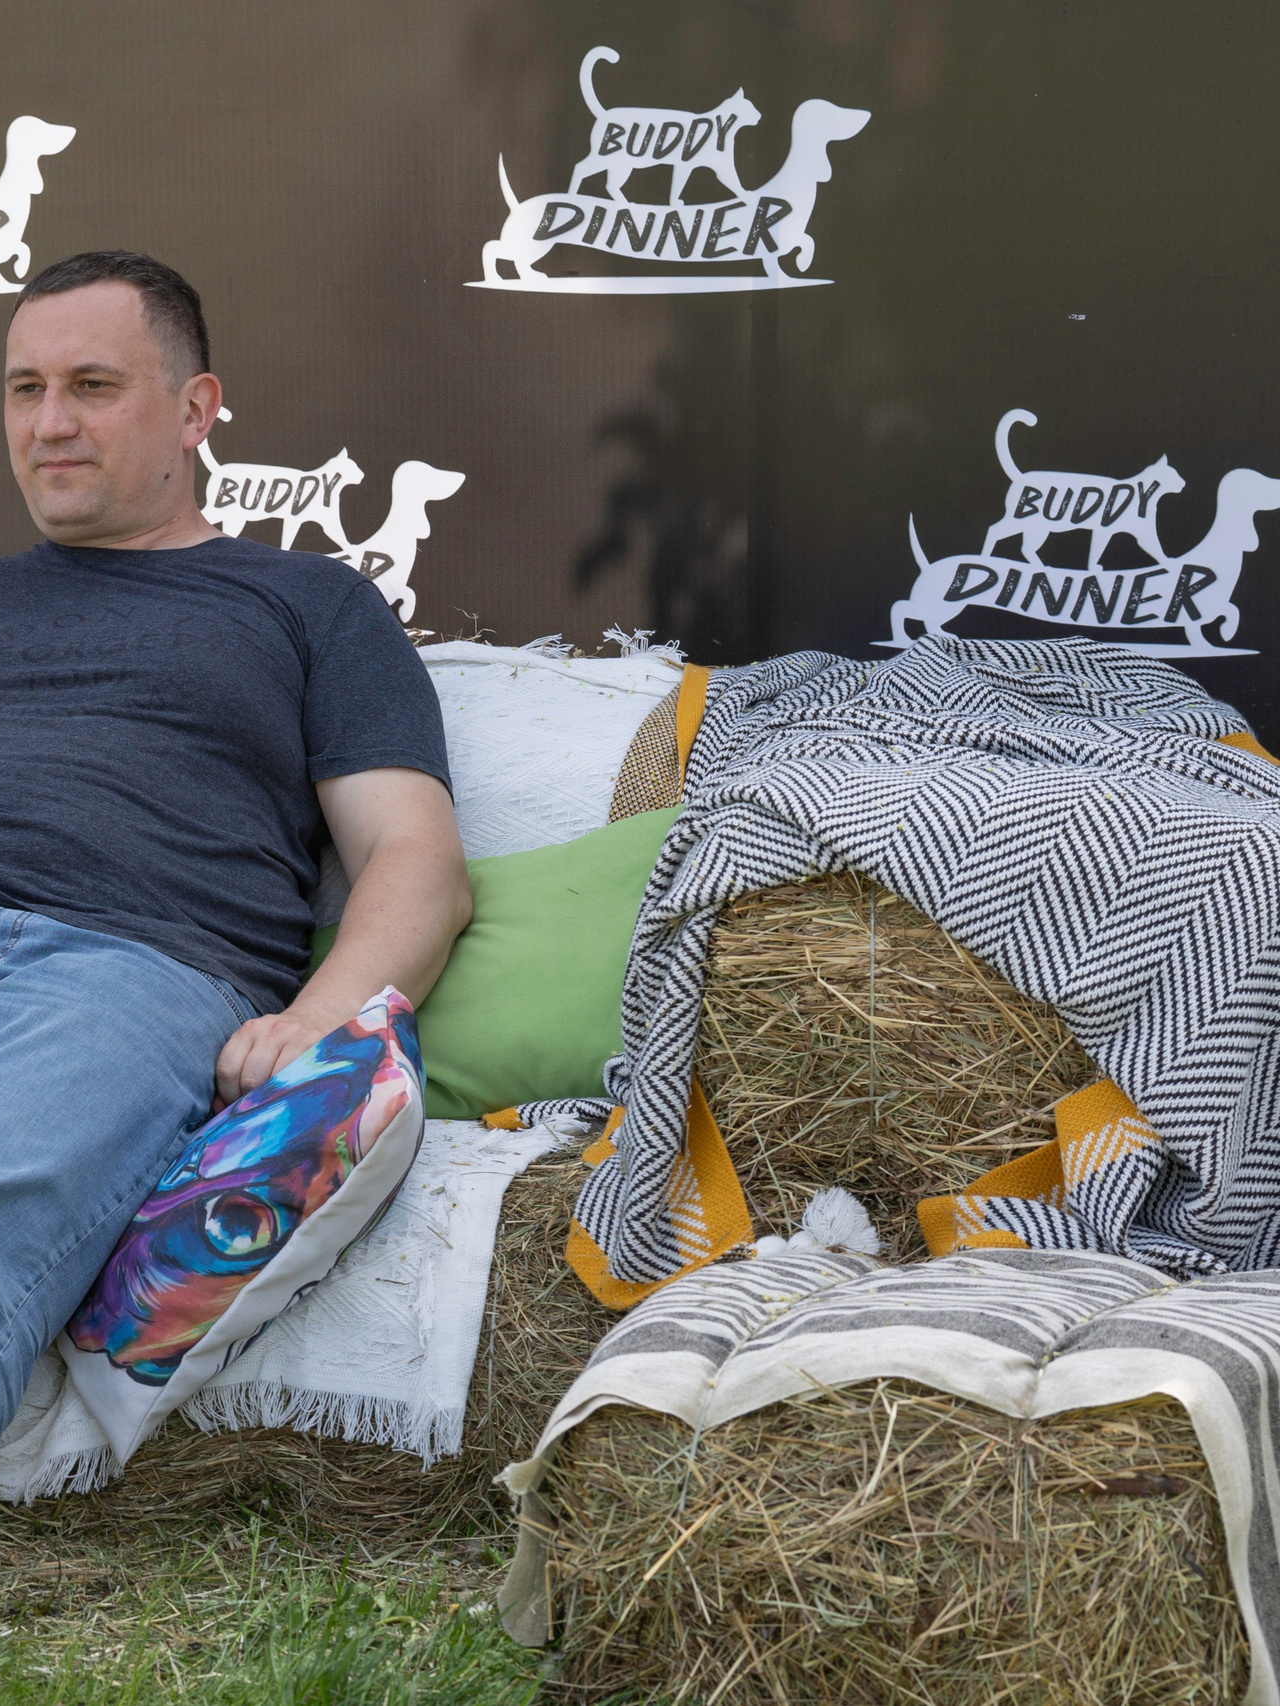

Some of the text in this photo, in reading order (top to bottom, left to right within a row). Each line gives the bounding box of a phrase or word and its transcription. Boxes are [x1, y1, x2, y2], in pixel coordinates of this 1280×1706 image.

[598, 114, 736, 162] BUDDY
[536, 197, 792, 259] DINNER
[214, 471, 341, 516] BUDDY
[1014, 480, 1160, 528] BUDDY
[943, 563, 1218, 624] DINNER
